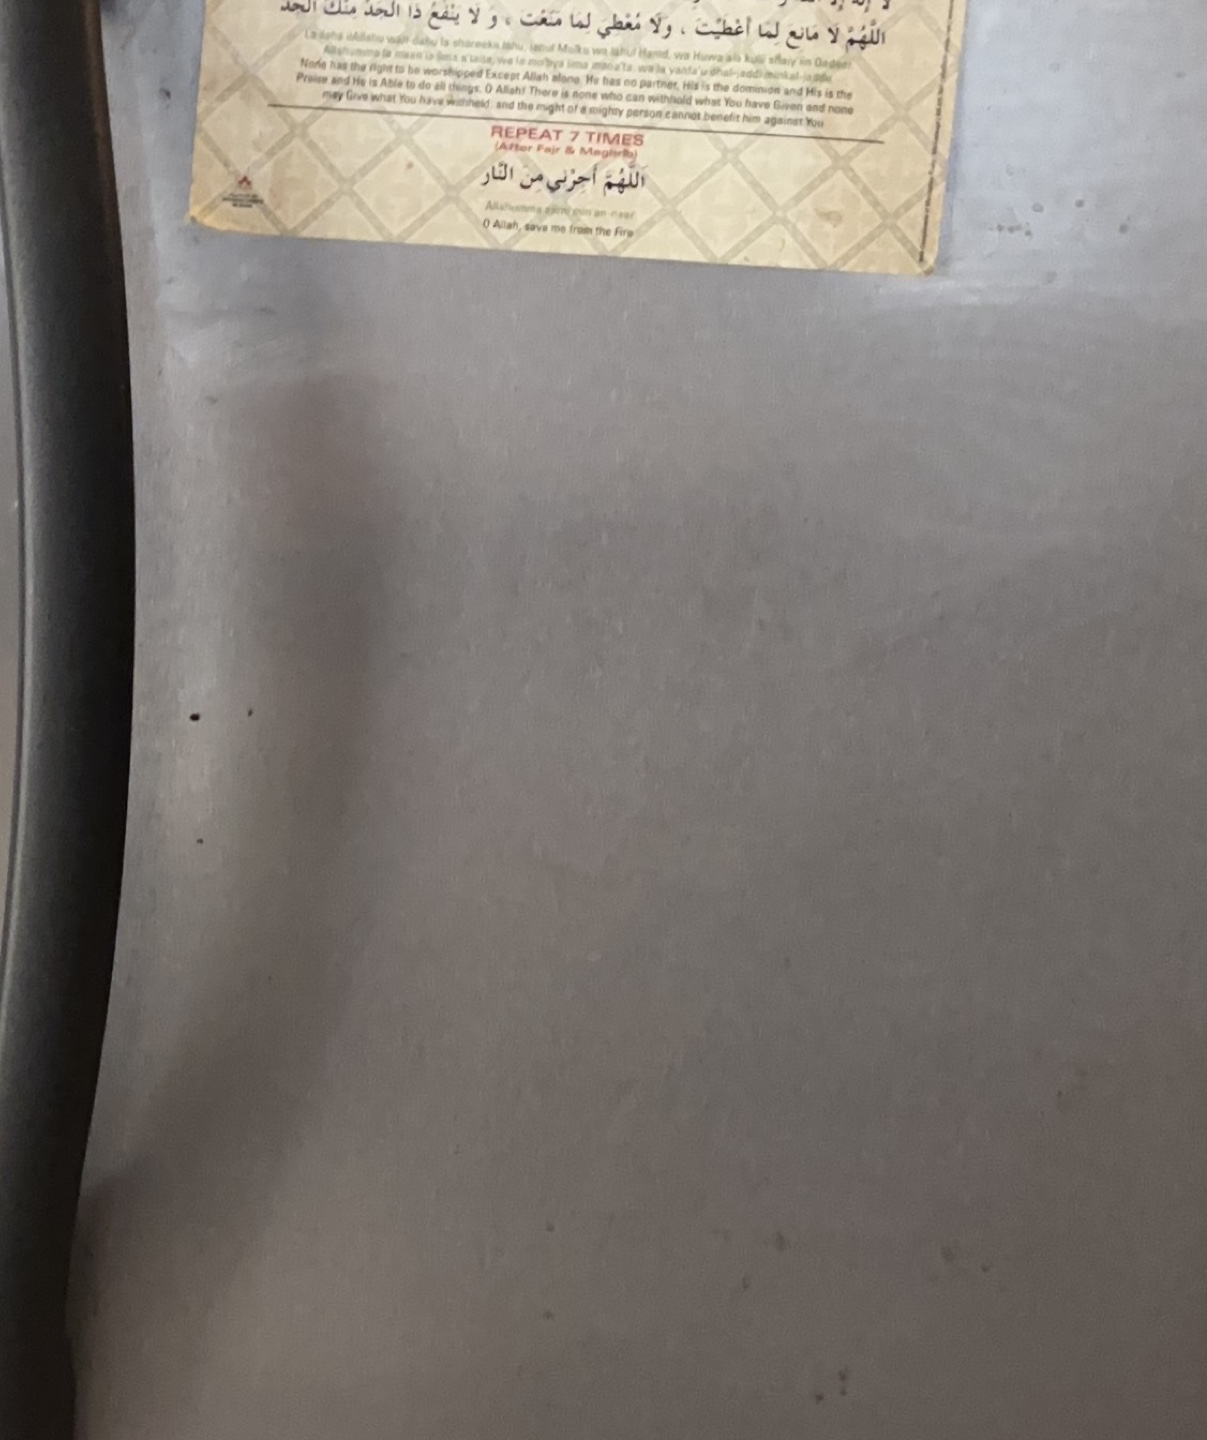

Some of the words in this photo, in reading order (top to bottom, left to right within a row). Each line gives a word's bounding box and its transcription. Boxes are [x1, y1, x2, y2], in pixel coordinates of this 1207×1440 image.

[296, 72, 328, 83] Praise
[330, 75, 350, 85] and
[352, 76, 366, 85] He
[368, 77, 377, 86] is
[379, 77, 402, 88] Able
[405, 80, 415, 88] to
[417, 80, 430, 89] do
[433, 81, 445, 90] all
[528, 86, 558, 97] There
[600, 90, 622, 101] who
[647, 93, 692, 105] withhold
[694, 96, 720, 106] what
[724, 98, 742, 108] You
[744, 99, 770, 109] have
[772, 101, 802, 111] Given
[805, 103, 824, 113] and
[490, 126, 563, 140] REPEAT
[568, 130, 579, 141] 7
[585, 131, 644, 145] TIMES
[494, 141, 532, 152] (After
[536, 144, 560, 156] Fajr
[564, 145, 575, 154] &
[578, 146, 637, 160] Maghrib)
[482, 219, 490, 229] O
[492, 219, 521, 231] Allah,
[523, 224, 547, 232] save
[568, 224, 592, 234] from
[594, 225, 610, 235] the
[613, 226, 634, 236] Fire
